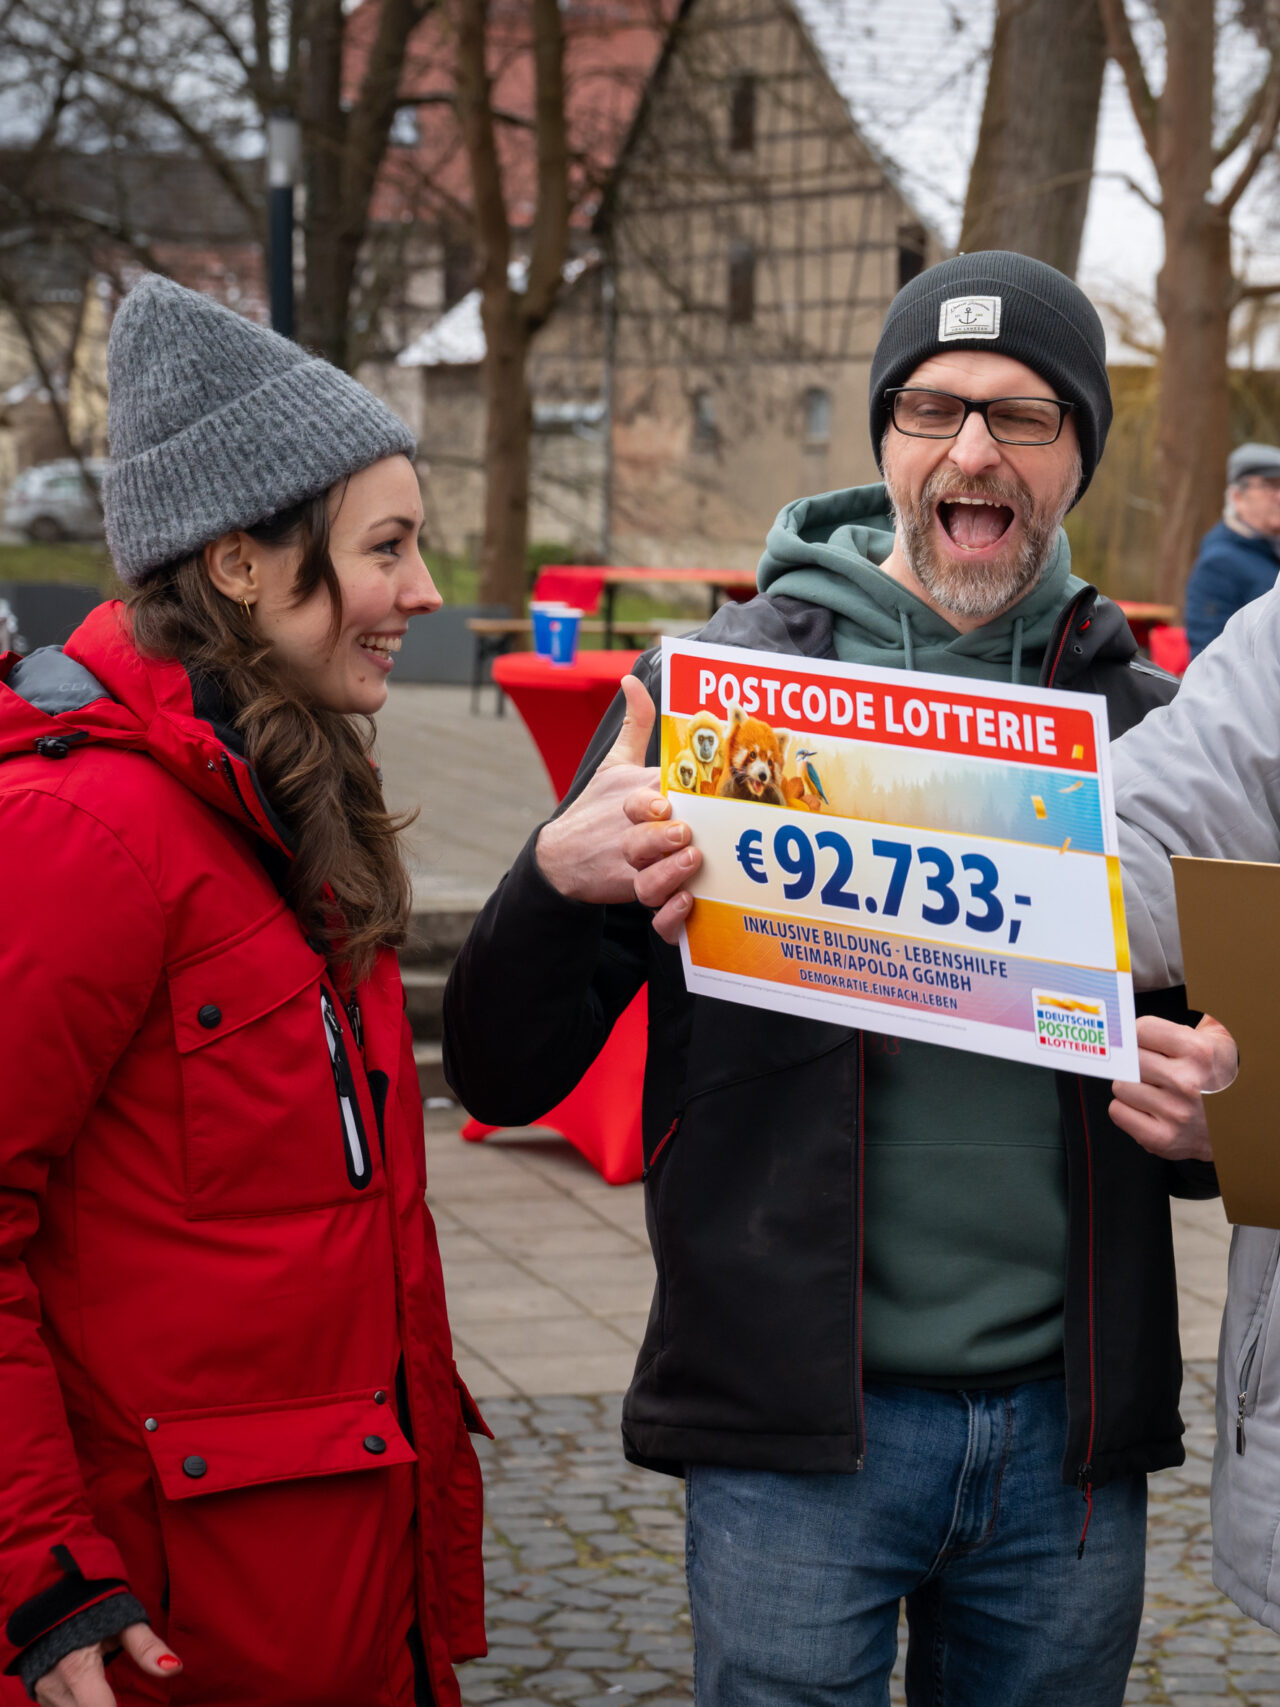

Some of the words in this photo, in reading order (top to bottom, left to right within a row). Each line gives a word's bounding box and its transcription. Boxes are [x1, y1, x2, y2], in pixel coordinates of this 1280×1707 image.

[699, 669, 876, 730] POSTCODE
[884, 695, 1058, 755] LOTTERIE
[743, 915, 821, 945] INKLUSIVE
[823, 930, 892, 957] BILDUNG
[904, 945, 1008, 978] LEBENSHILFE
[780, 942, 909, 980] WEIMAR/APOLDA
[912, 967, 972, 992] GGMBH
[799, 969, 958, 1010] DEMOKRATIE.EINFACH.LEBEN
[1038, 1020, 1106, 1045] POSTCODE
[1045, 1010, 1096, 1028] DEUTSCHE
[1047, 1037, 1098, 1055] LOTTERIE
